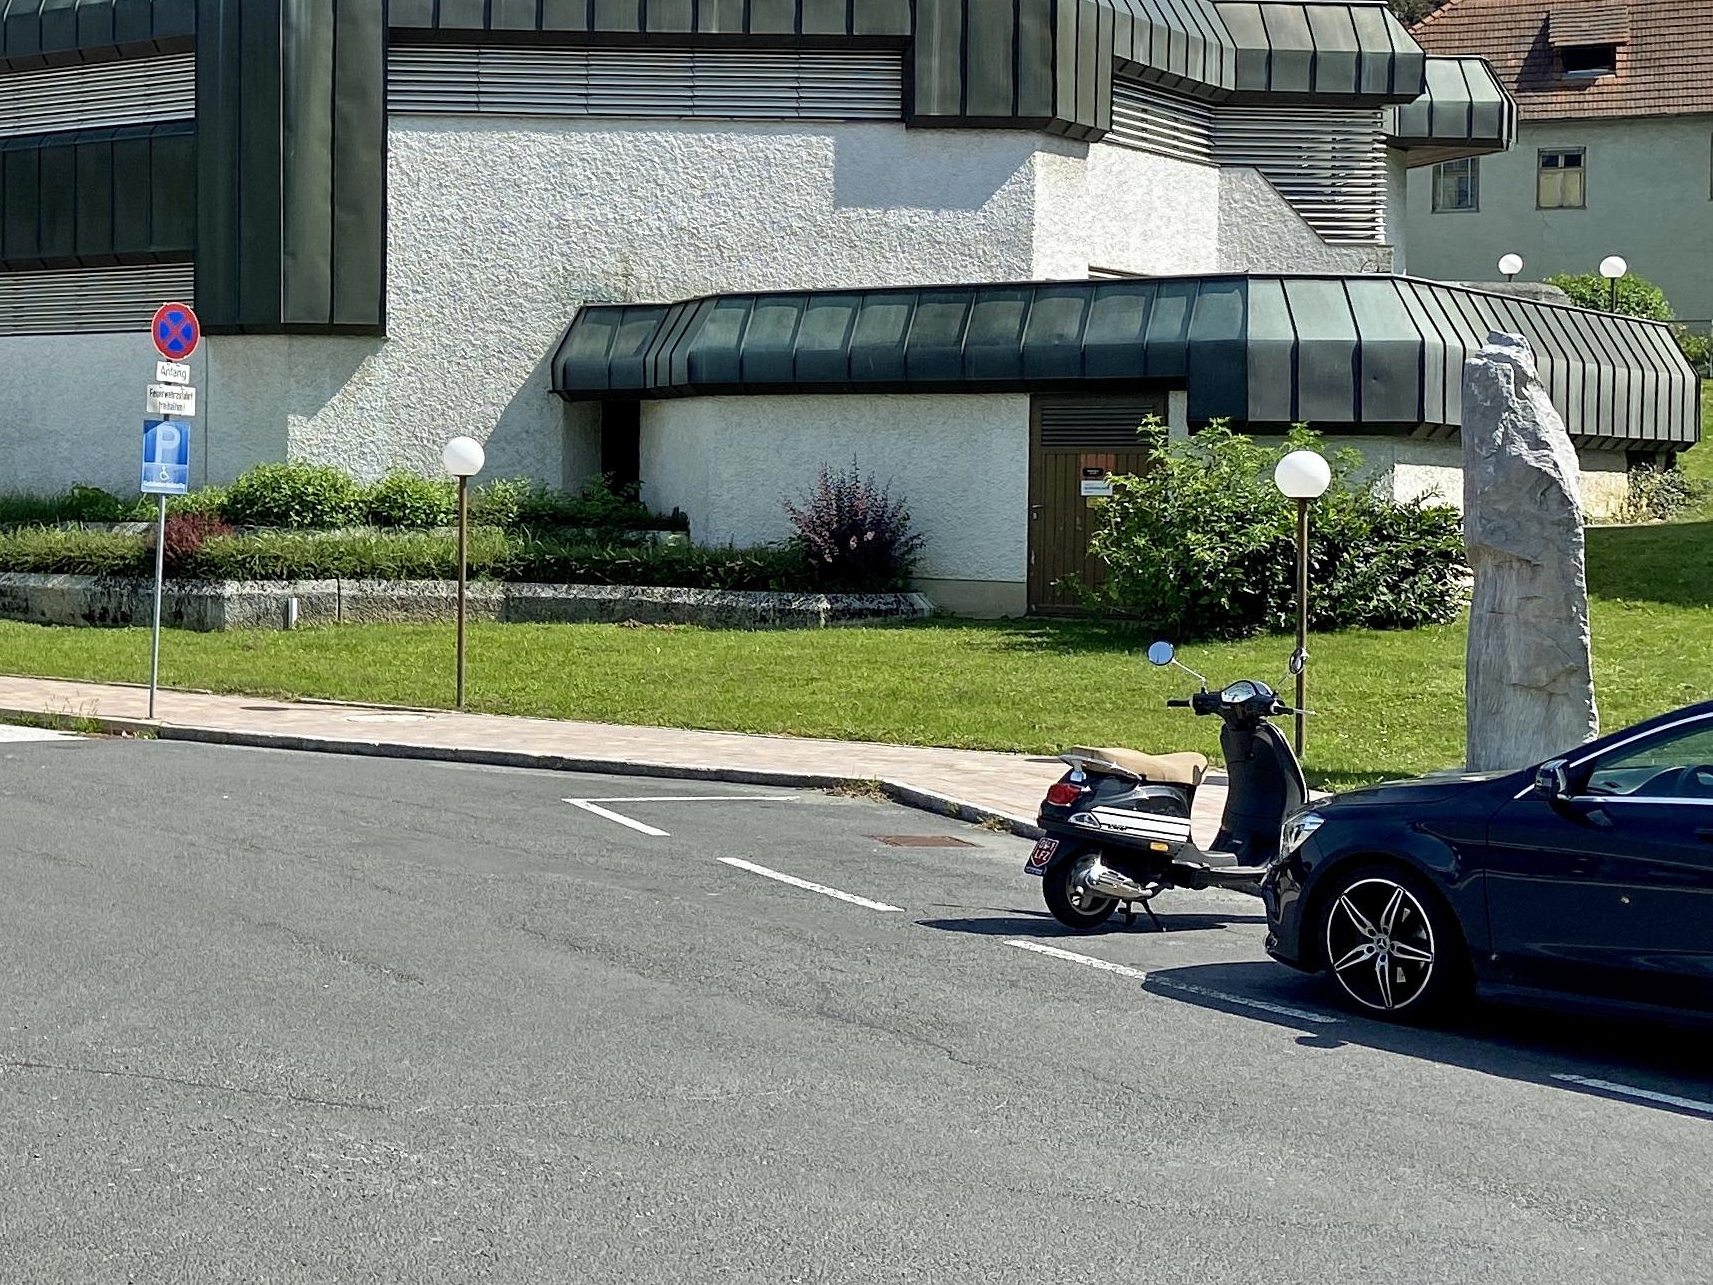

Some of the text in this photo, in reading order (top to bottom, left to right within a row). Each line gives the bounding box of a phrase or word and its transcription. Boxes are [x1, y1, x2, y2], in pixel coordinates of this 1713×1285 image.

[160, 365, 187, 381] Anfang
[155, 425, 181, 463] P
[1034, 849, 1050, 861] LFZ
